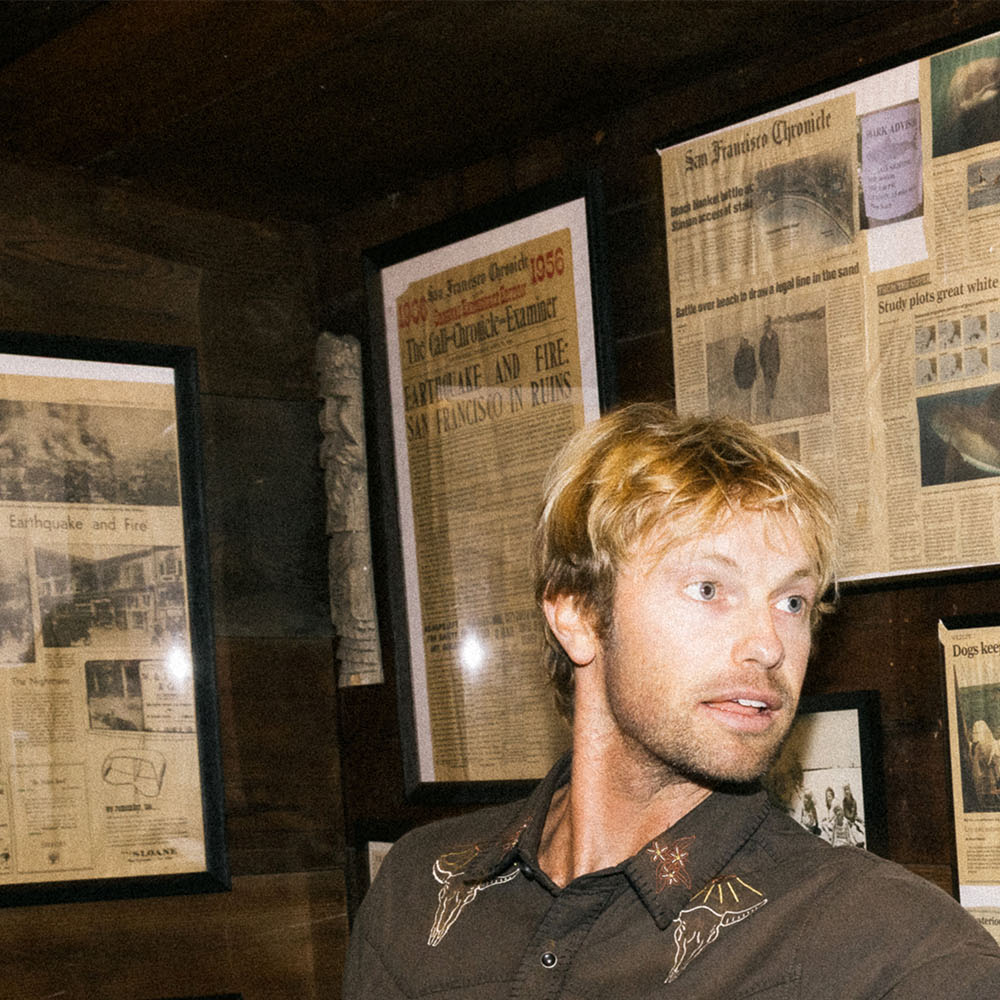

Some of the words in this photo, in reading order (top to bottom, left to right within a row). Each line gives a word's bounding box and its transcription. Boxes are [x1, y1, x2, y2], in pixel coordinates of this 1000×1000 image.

[685, 149, 709, 174] San
[711, 133, 769, 166] Francisco
[772, 109, 831, 146] Chronicle
[427, 284, 443, 302] San
[446, 272, 487, 298] Francisco
[488, 252, 529, 282] Chronicle
[530, 247, 566, 285] 1956
[878, 296, 907, 315] Study
[909, 290, 935, 310] plots
[936, 283, 965, 302] great
[967, 277, 1000, 296] white
[406, 338, 426, 365] The
[404, 363, 481, 412] EARTHQUAKE
[494, 352, 520, 385] AND
[534, 337, 570, 373] FIRE:
[406, 413, 428, 442] SAN
[436, 392, 503, 435] FRANCISCO
[509, 384, 524, 413] IN
[531, 371, 572, 408] RUINS
[10, 514, 84, 532] Earthquake
[93, 516, 117, 531] and
[124, 519, 149, 532] Fire
[952, 643, 979, 659] Dogs
